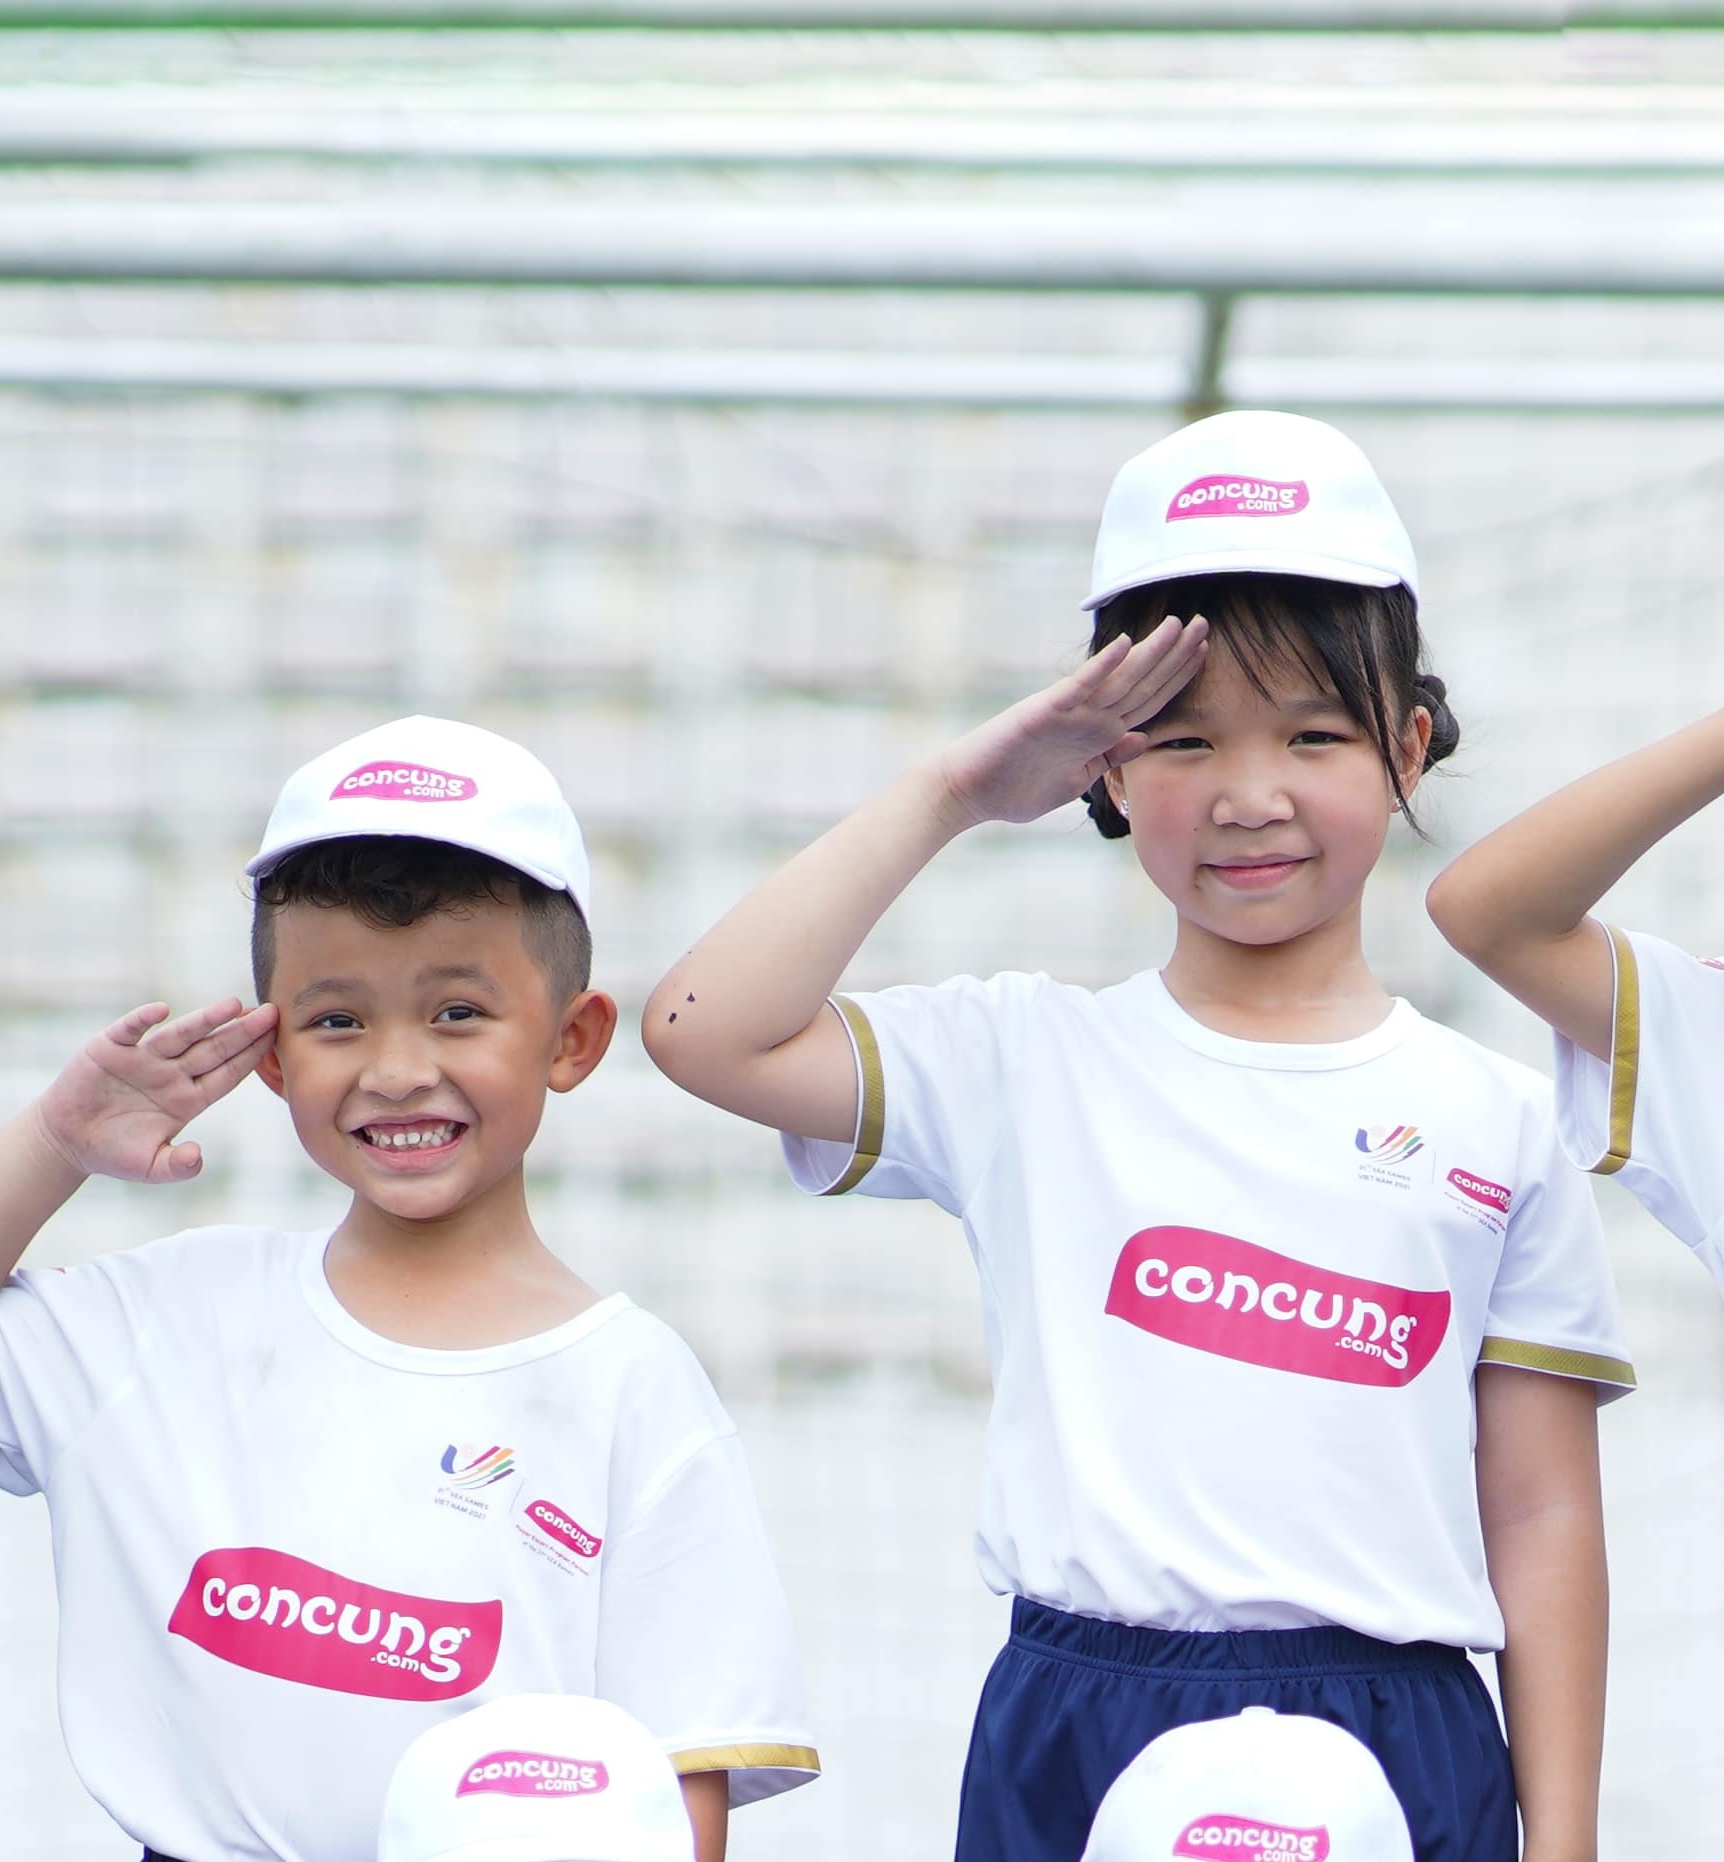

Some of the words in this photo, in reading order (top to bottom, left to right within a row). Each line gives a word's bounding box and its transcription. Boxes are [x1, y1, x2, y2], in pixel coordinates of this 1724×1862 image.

[1178, 482, 1299, 509] concung
[342, 769, 466, 796] concung
[1134, 1258, 1418, 1370] concung
[1334, 1336, 1382, 1357] .com
[535, 1506, 596, 1554] concung
[202, 1577, 472, 1683] concung
[370, 1651, 420, 1672] .com
[467, 1760, 598, 1789] concung
[535, 1779, 579, 1792] .com
[1187, 1826, 1319, 1862] concung
